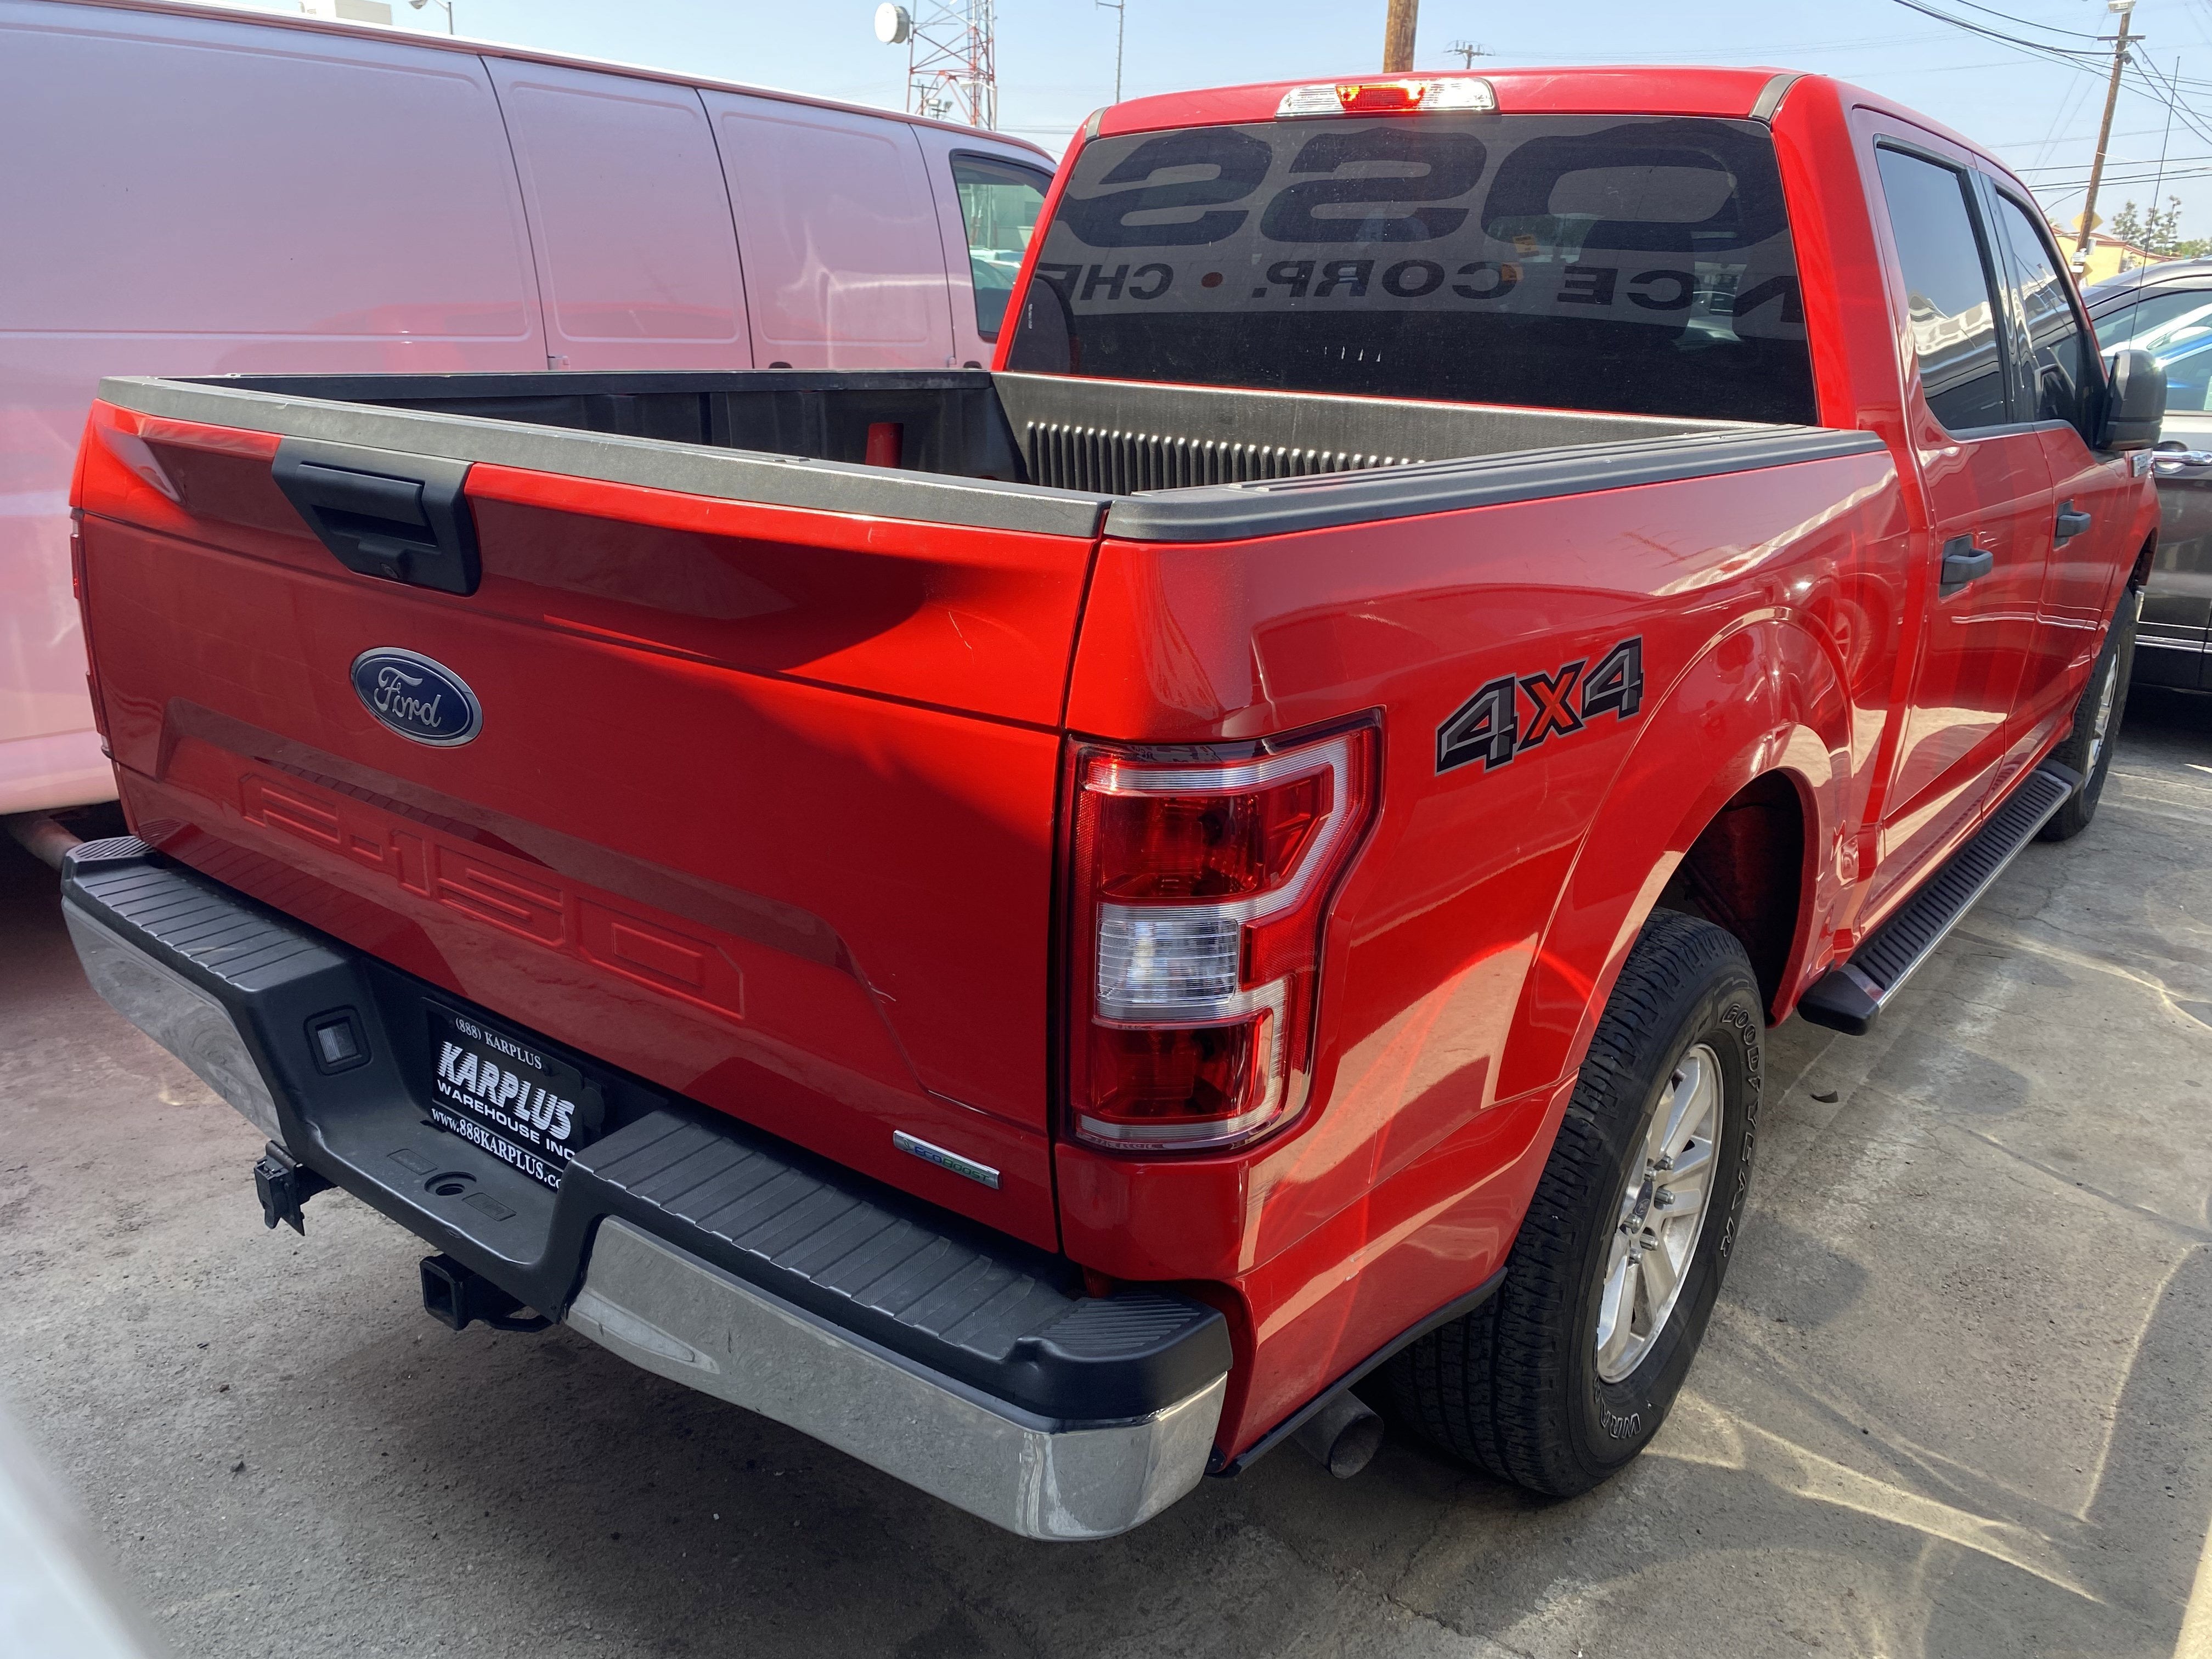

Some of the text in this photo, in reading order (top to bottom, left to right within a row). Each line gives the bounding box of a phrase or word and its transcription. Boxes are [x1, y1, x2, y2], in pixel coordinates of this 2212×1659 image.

[374, 667, 441, 727] Ford
[455, 1017, 543, 1070] (888) KARPLUS
[437, 1041, 575, 1140] KARPLUS
[437, 1079, 540, 1144] WAREHOUSE
[431, 1108, 561, 1189] www.888KARPLUS.co
[1721, 1003, 1762, 1258] GOODYEAR
